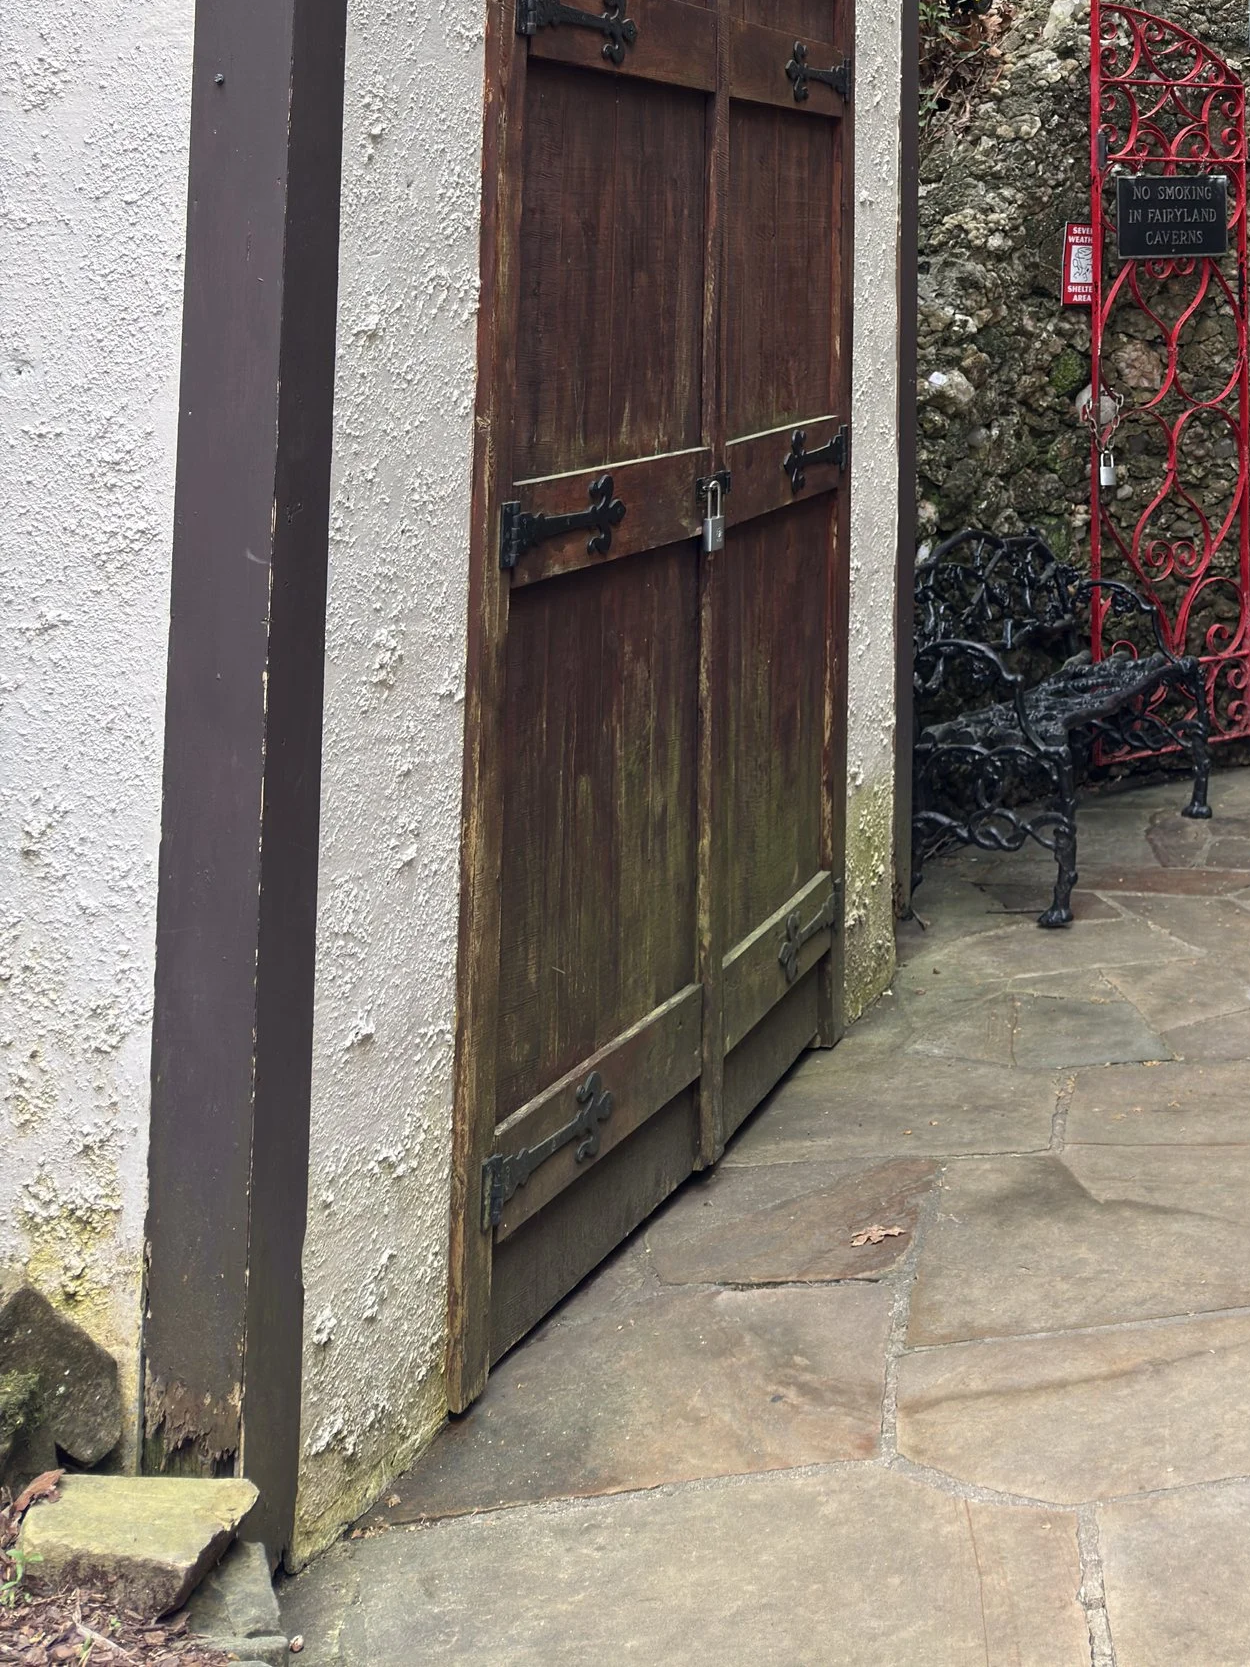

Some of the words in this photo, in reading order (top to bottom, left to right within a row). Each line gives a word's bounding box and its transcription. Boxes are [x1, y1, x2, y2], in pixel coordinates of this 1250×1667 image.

[1132, 185, 1151, 200] NO
[1157, 186, 1213, 200] SMOKING
[1128, 209, 1143, 224] IN
[1147, 208, 1217, 223] FAIRYLAND
[1072, 226, 1093, 235] SEVE
[1068, 235, 1093, 244] WEATH
[1145, 230, 1204, 245] CAVERNS
[1067, 285, 1093, 293] SHELTE
[1072, 294, 1092, 302] AREA
